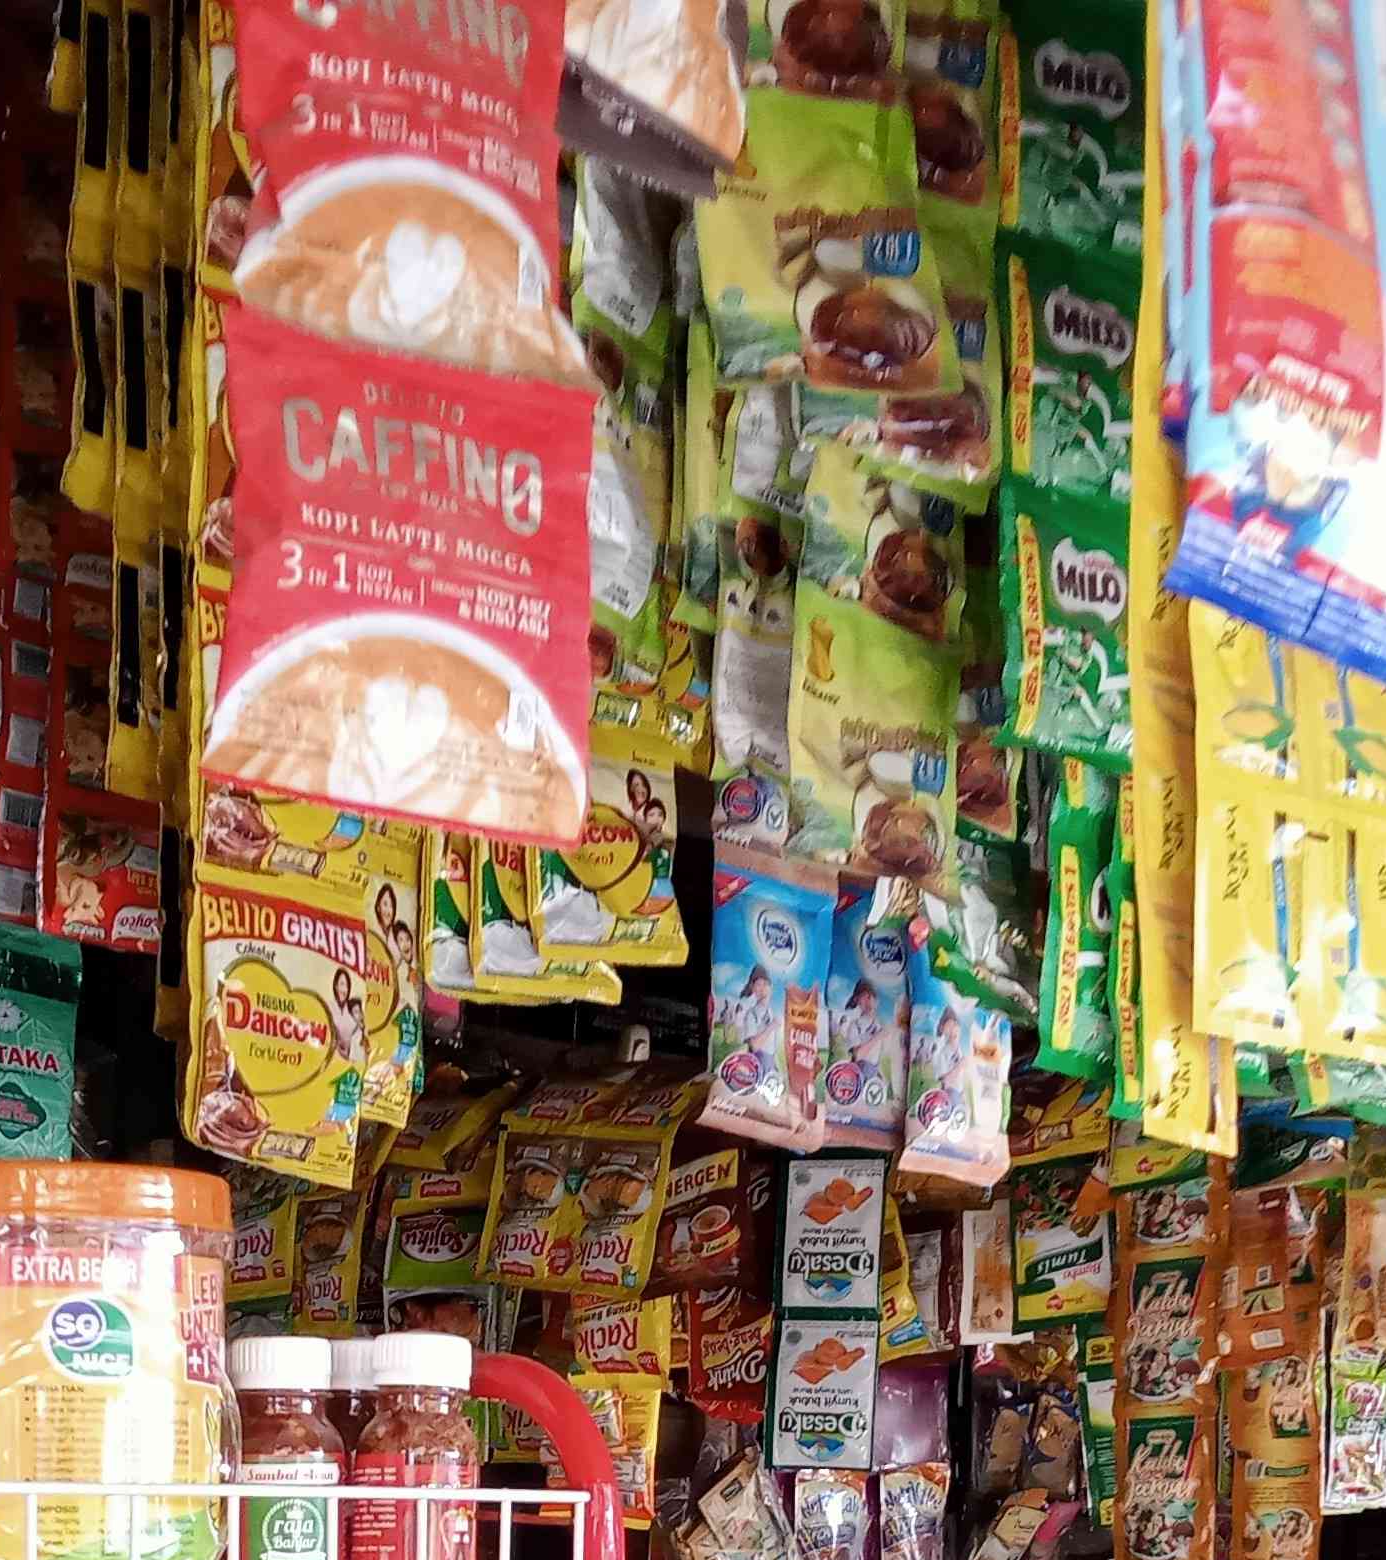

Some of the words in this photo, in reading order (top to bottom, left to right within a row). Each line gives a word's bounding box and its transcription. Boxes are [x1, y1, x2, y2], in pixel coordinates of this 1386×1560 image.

[1041, 58, 1129, 101] MILO
[1051, 309, 1131, 352] MILO
[281, 396, 544, 537] CAFFINO
[301, 503, 360, 535] KOPI
[370, 516, 448, 552] LATTE
[456, 538, 533, 577] MOCCA
[276, 538, 304, 590] 3
[332, 551, 351, 593] 1
[1055, 563, 1121, 606] MILO
[281, 910, 356, 972] GRATIS
[225, 989, 328, 1047] Dancow
[665, 1160, 734, 1196] NERGEN
[231, 1227, 275, 1259] Raci
[493, 1229, 549, 1262] Racik
[575, 1233, 633, 1267] Racik
[797, 1234, 827, 1249] bubuk
[830, 1232, 867, 1250] kunyit
[11, 1255, 75, 1284] EXTRA
[77, 1255, 139, 1283] BER
[786, 1249, 875, 1280] Desaku
[1034, 1246, 1089, 1277] Tumis
[305, 1276, 343, 1306] Racik
[53, 1312, 101, 1339] SO
[575, 1317, 639, 1365] Racik
[708, 1350, 767, 1391] Drink
[788, 1394, 821, 1410] bubuk
[823, 1392, 860, 1411] kunyit
[778, 1411, 869, 1441] Desaku
[247, 1464, 299, 1482] Sambal
[272, 1534, 318, 1554] Banjar
